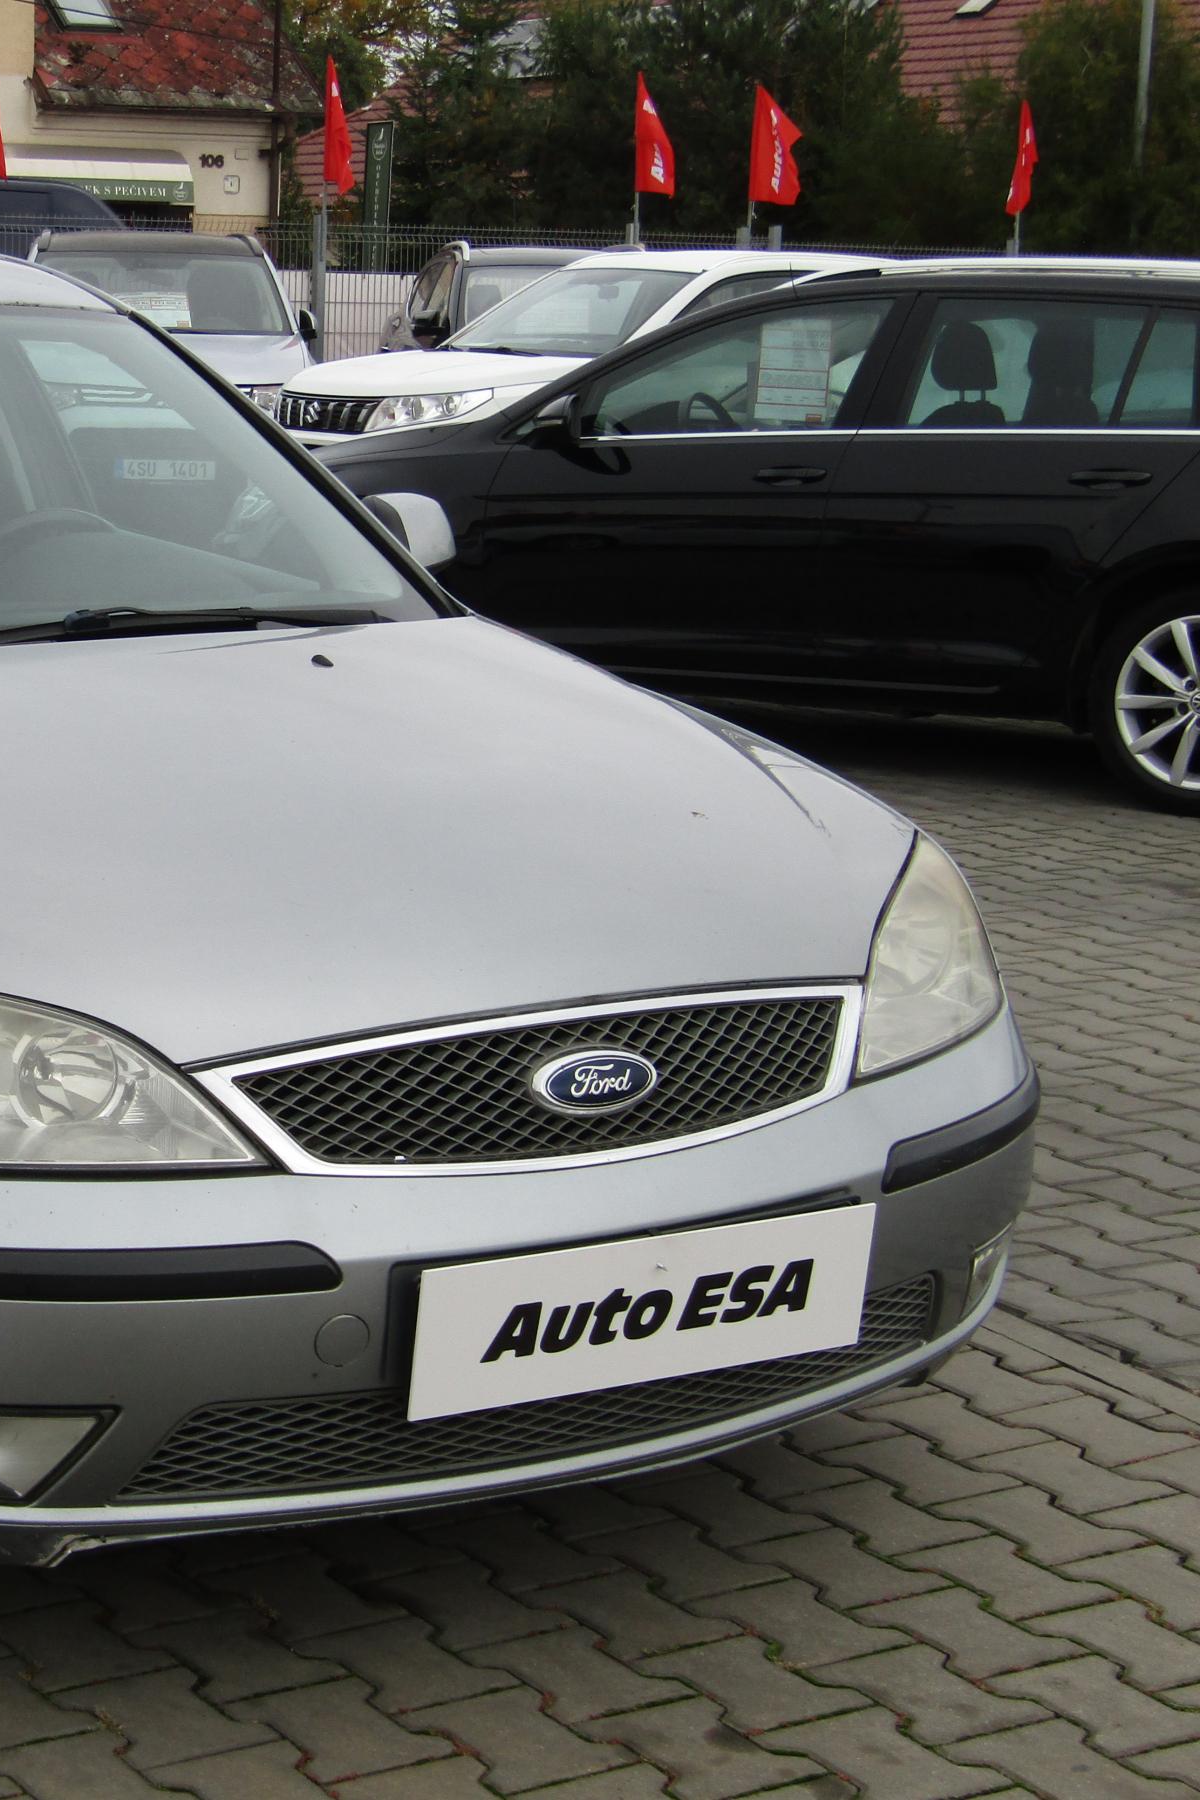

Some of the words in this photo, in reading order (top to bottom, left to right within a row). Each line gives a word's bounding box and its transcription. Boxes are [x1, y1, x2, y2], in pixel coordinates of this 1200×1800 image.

[199, 154, 224, 168] 106
[104, 185, 111, 195] S
[115, 183, 166, 197] PEČIVEM
[127, 461, 157, 478] 4SU
[169, 462, 208, 478] 1401
[570, 1063, 632, 1098] Ford
[480, 1287, 674, 1363] Auto
[676, 1258, 815, 1331] ESA
